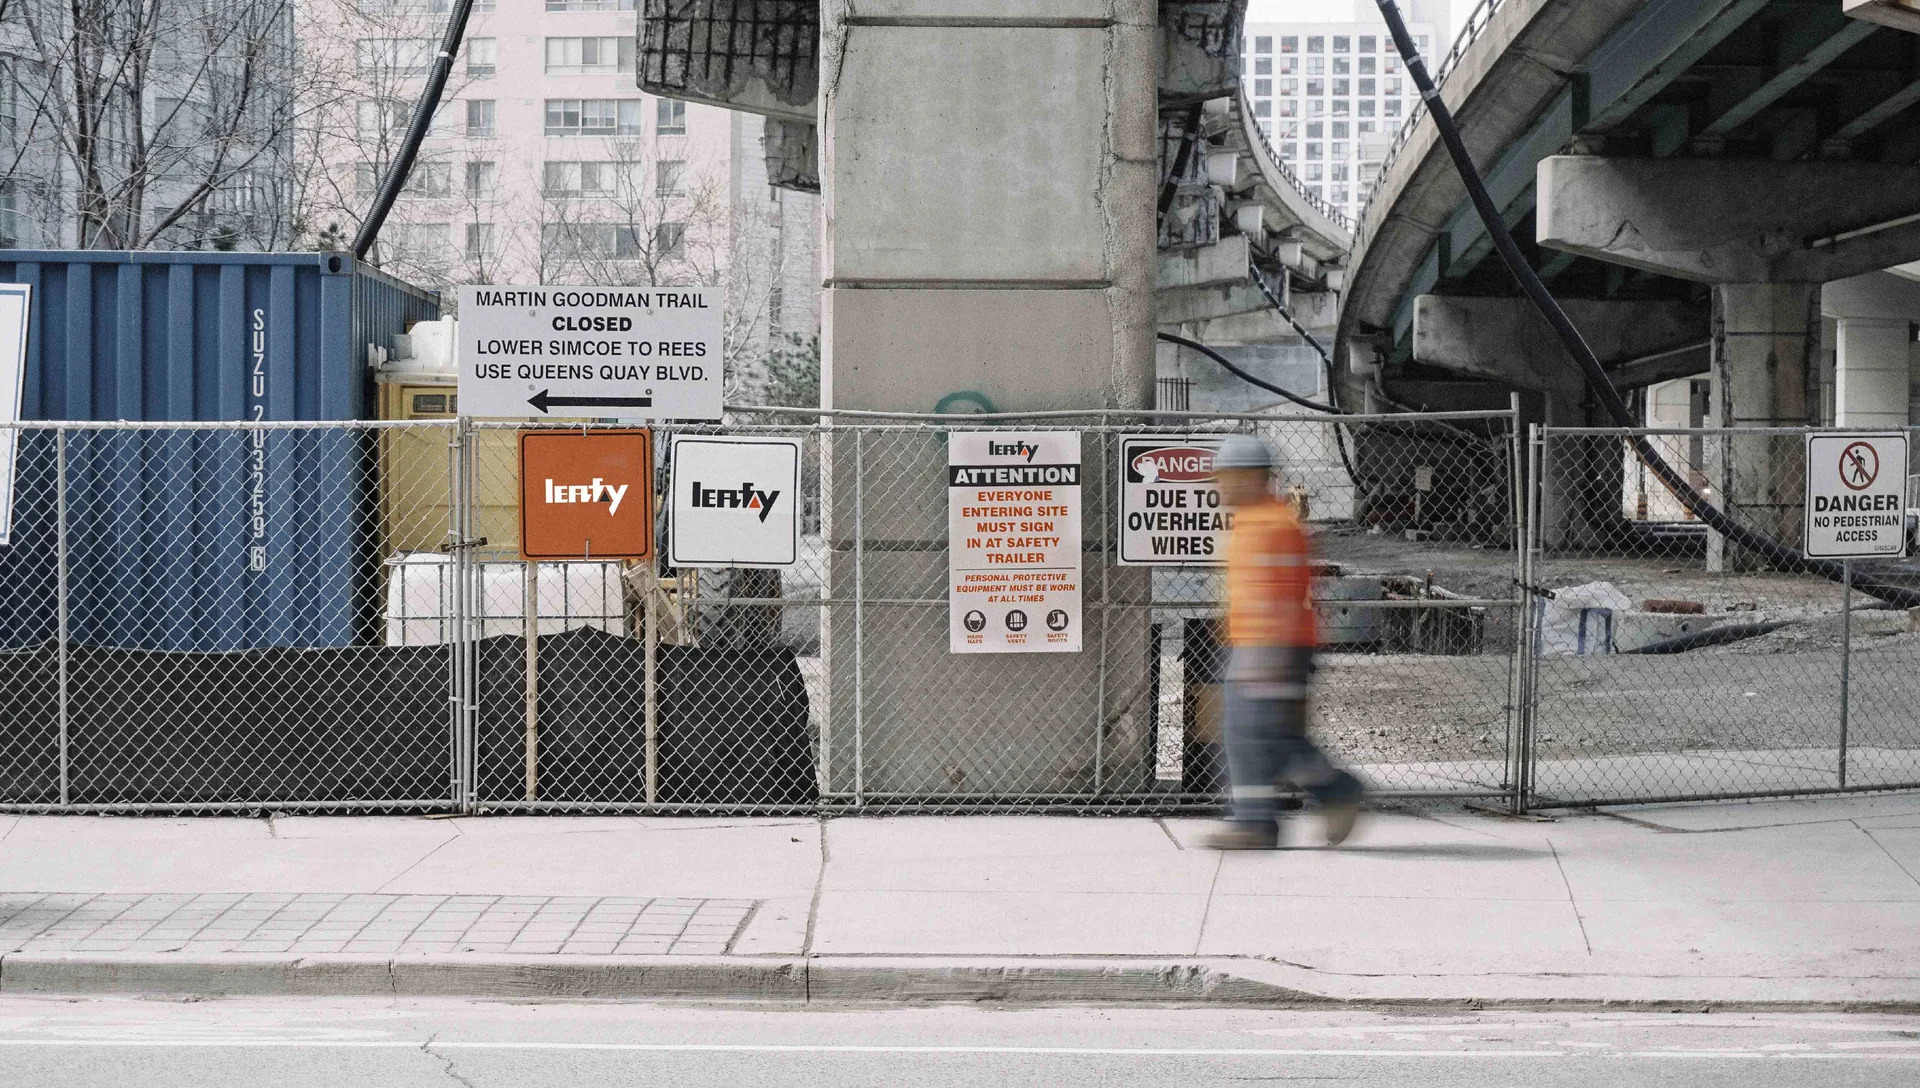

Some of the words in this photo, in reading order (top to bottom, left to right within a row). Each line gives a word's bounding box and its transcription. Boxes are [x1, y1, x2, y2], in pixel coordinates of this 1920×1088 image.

[475, 291, 547, 307] MARTIN
[552, 292, 650, 308] GOODMAN
[656, 293, 708, 309] TRAIL
[552, 316, 633, 332] CLOSED
[253, 308, 265, 397] SUZU
[477, 340, 543, 355] LOWER
[549, 340, 622, 356] SIMCOE
[627, 341, 652, 356] TO
[658, 342, 707, 357] REES
[475, 364, 511, 379] USE
[517, 364, 594, 380] QUEENS
[599, 365, 651, 381] QUAY
[656, 366, 709, 381] BLVD.
[954, 467, 1076, 484] ATTENTION
[978, 490, 1053, 502] EVERYONE
[1145, 489, 1187, 508] DUE
[1193, 489, 1221, 508] TO
[1814, 494, 1899, 512] DANGER
[962, 506, 1033, 518] ENTERING
[1037, 505, 1068, 517] SITE
[976, 522, 1016, 533] MUST
[1020, 521, 1054, 532] SIGN
[1814, 516, 1830, 528] NO
[1833, 515, 1899, 527] PEDESTRIAN
[966, 538, 981, 548] IN
[985, 538, 1002, 548] AT
[1007, 537, 1060, 548] SAFETY
[1835, 530, 1878, 542] ACCESS
[1151, 536, 1215, 555] WIRES
[252, 547, 265, 570] 6
[986, 552, 1045, 564] TRAILER
[965, 574, 1011, 582] PERSONAL
[1013, 573, 1067, 581] PROTECTIVE
[956, 585, 1007, 593] EQUIPMENT
[1009, 584, 1034, 592] MUST
[1035, 584, 1047, 592] BE
[988, 595, 999, 603] AT
[1000, 595, 1017, 603] ALL
